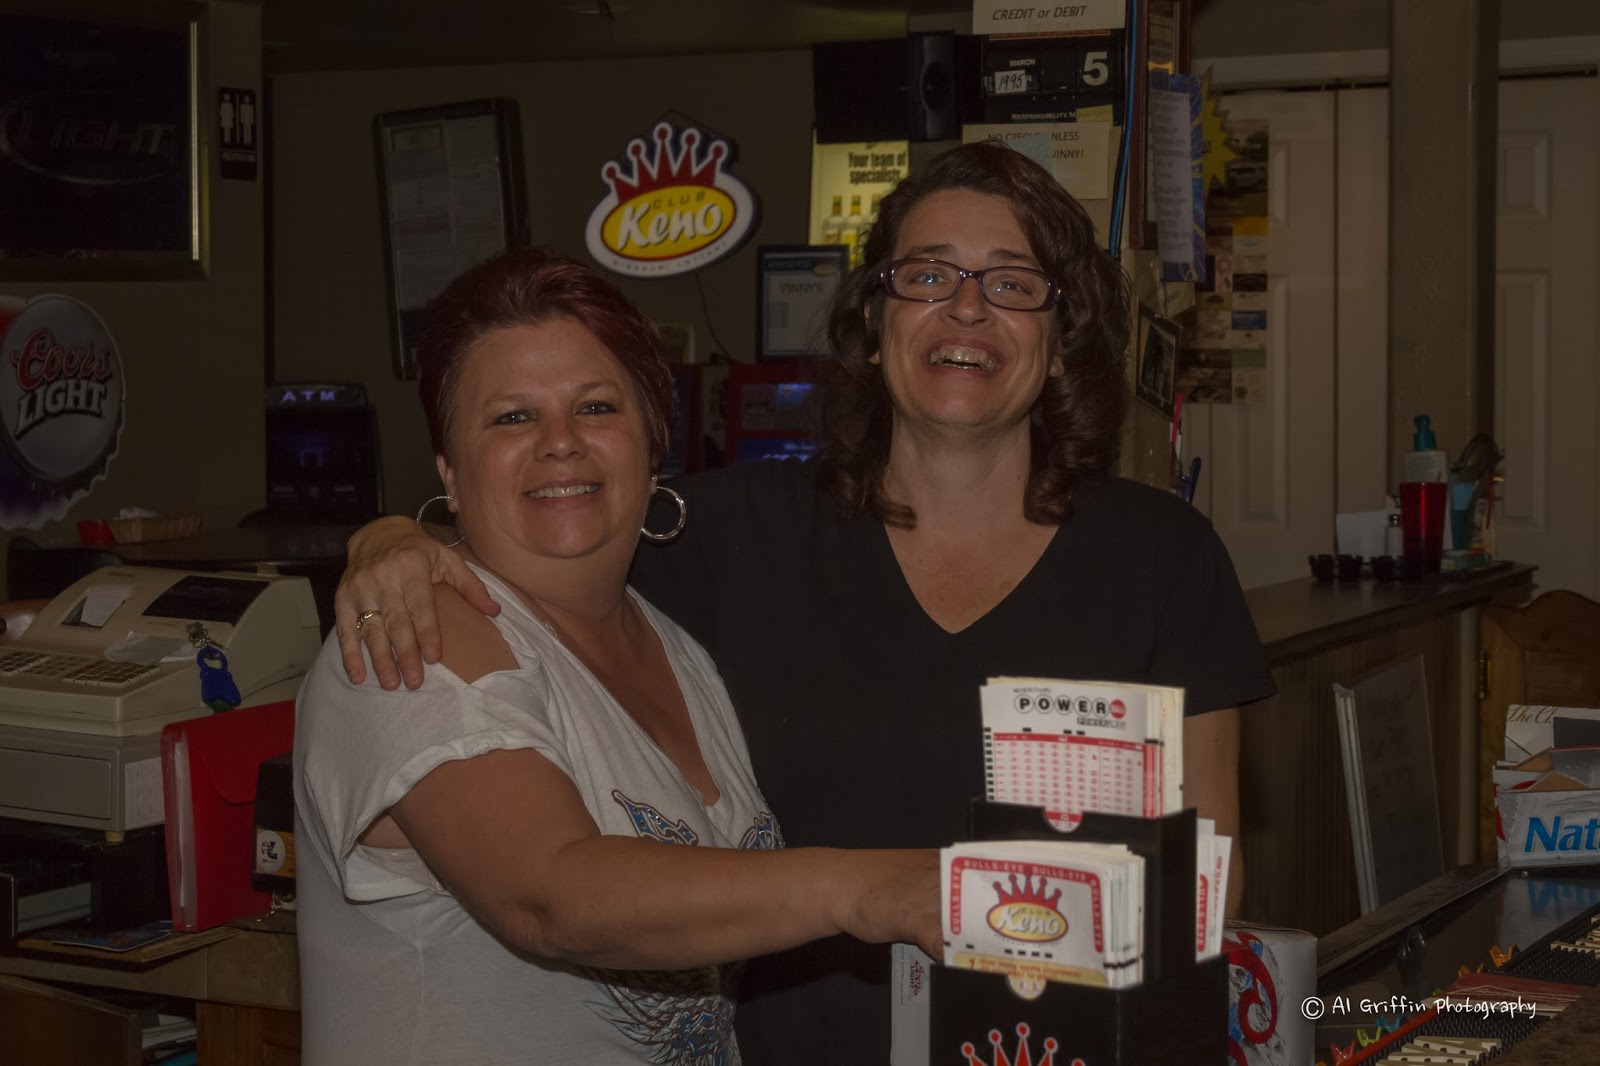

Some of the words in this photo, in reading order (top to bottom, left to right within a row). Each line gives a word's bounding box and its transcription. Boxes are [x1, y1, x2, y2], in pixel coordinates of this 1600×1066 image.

[992, 8, 1036, 21] CREDIT
[1037, 9, 1051, 19] or
[1053, 5, 1088, 18] DEBIT
[1009, 58, 1036, 67] MARCH
[1082, 51, 1109, 86] 5
[998, 73, 1025, 91] 1995
[1051, 131, 1080, 142] NLESS
[848, 152, 870, 168] Your
[871, 152, 895, 167] team
[896, 151, 907, 167] of
[849, 169, 902, 185] specialists
[653, 191, 705, 209] CLUB
[616, 201, 723, 251] Keno
[10, 328, 112, 392] Coors
[280, 389, 336, 404] ATM
[15, 377, 108, 440] LIGHT
[1017, 696, 1107, 715] POWER
[1508, 705, 1534, 723] The
[1535, 705, 1559, 724] Ch
[1524, 815, 1600, 853] Nat
[996, 905, 1061, 935] Keno
